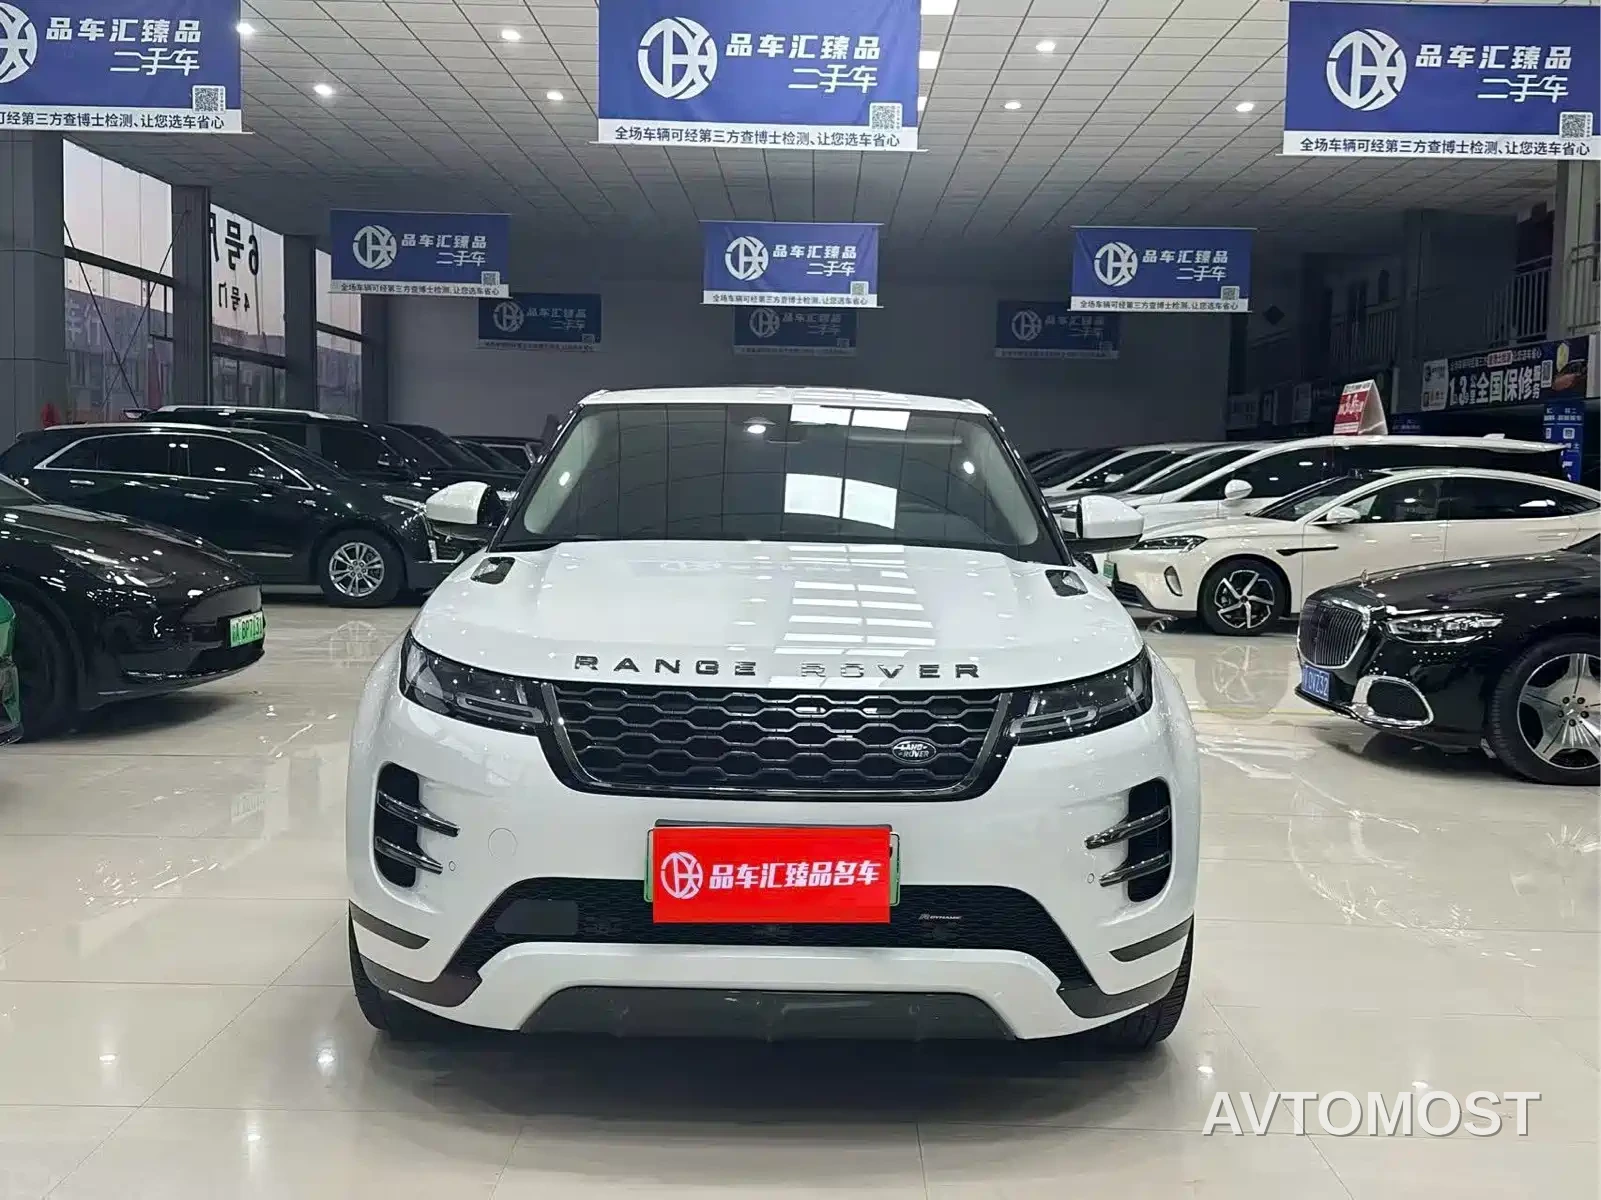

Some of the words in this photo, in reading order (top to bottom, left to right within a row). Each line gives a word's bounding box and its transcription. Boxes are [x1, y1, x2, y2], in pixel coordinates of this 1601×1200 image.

[46, 17, 201, 43] 品车汇臻品
[725, 33, 880, 60] 品车汇臻品
[110, 48, 200, 76] 二手车
[1415, 44, 1572, 70] 品车汇臻品
[788, 64, 878, 94] 二手车
[1477, 74, 1569, 103] 二手车
[401, 233, 487, 249] 品车汇臻品
[436, 251, 486, 267] 二手车
[772, 244, 857, 260] 品车汇臻品
[1142, 250, 1228, 264] 品车汇臻品
[806, 261, 855, 277] 二手车
[1176, 265, 1226, 282] 二手车
[574, 655, 756, 677] RANGE
[801, 663, 981, 679] ROVER
[901, 743, 923, 751] LAND
[903, 750, 929, 758] ROVER
[709, 859, 882, 890] 品车汇臻品名车
